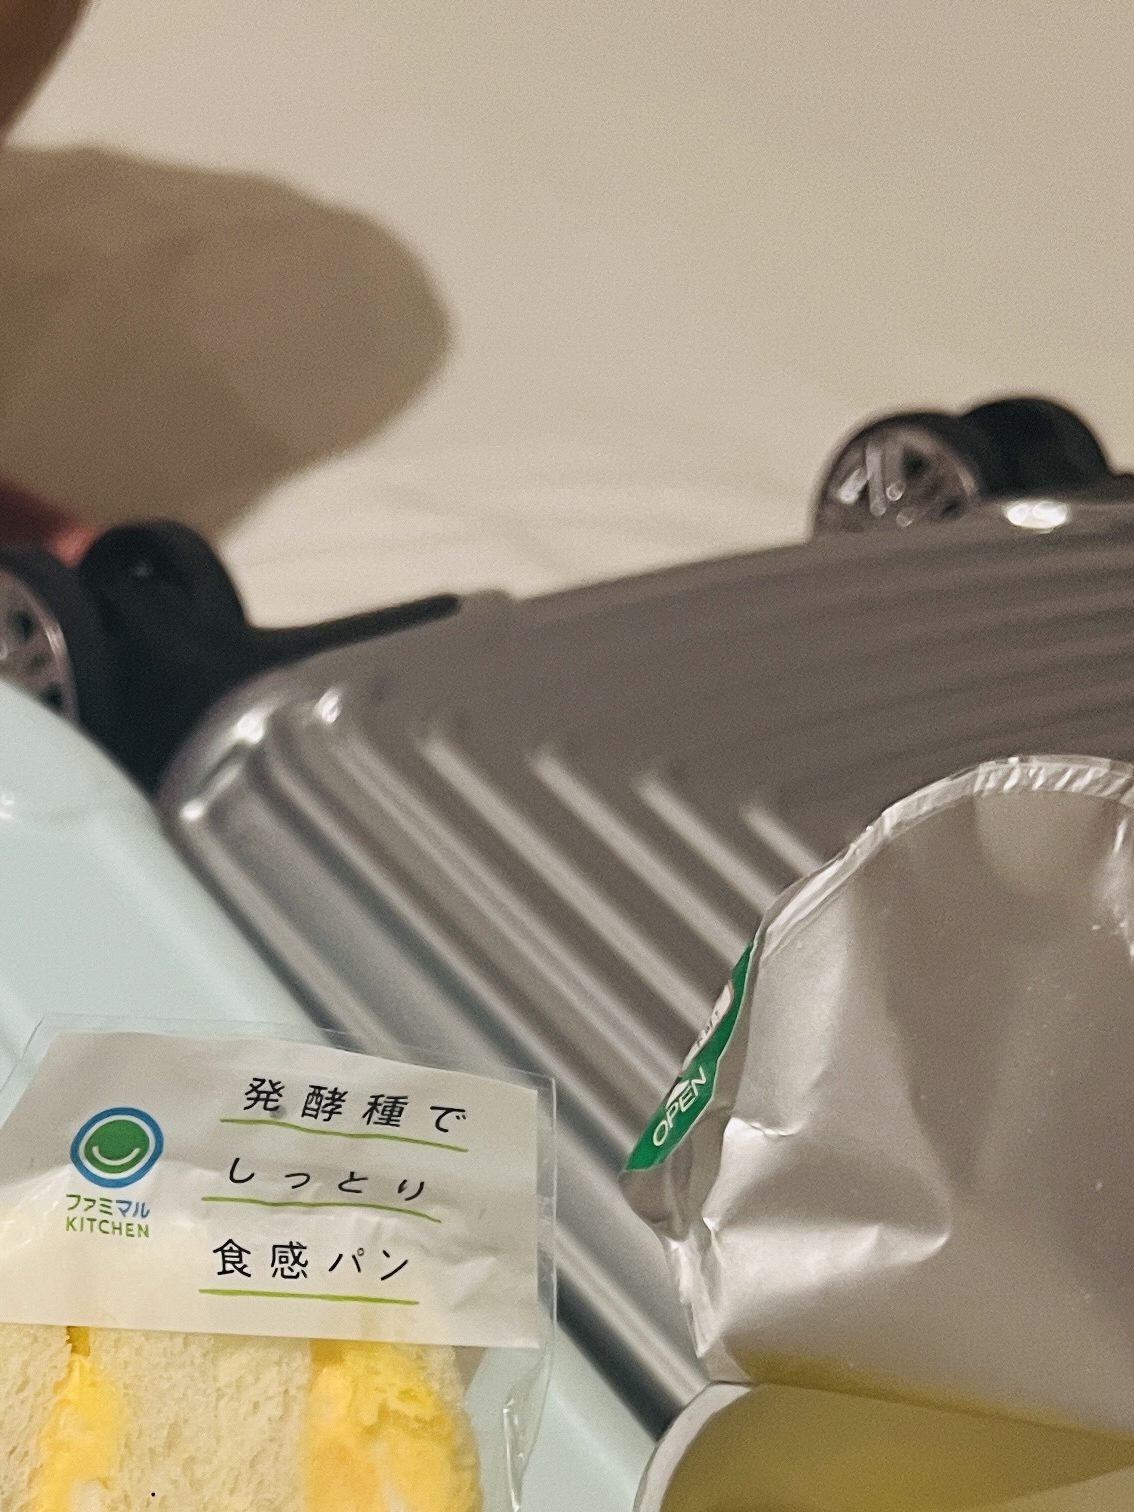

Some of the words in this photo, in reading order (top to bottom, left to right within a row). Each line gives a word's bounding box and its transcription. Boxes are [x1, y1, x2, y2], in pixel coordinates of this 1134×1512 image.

[243, 1078, 467, 1133] 発酵種で
[653, 1066, 706, 1147] OPEN
[229, 1157, 425, 1201] しっとり
[66, 1194, 150, 1219] ファミマル
[66, 1216, 149, 1238] KITCHEN
[213, 1239, 409, 1281] 食感パン
